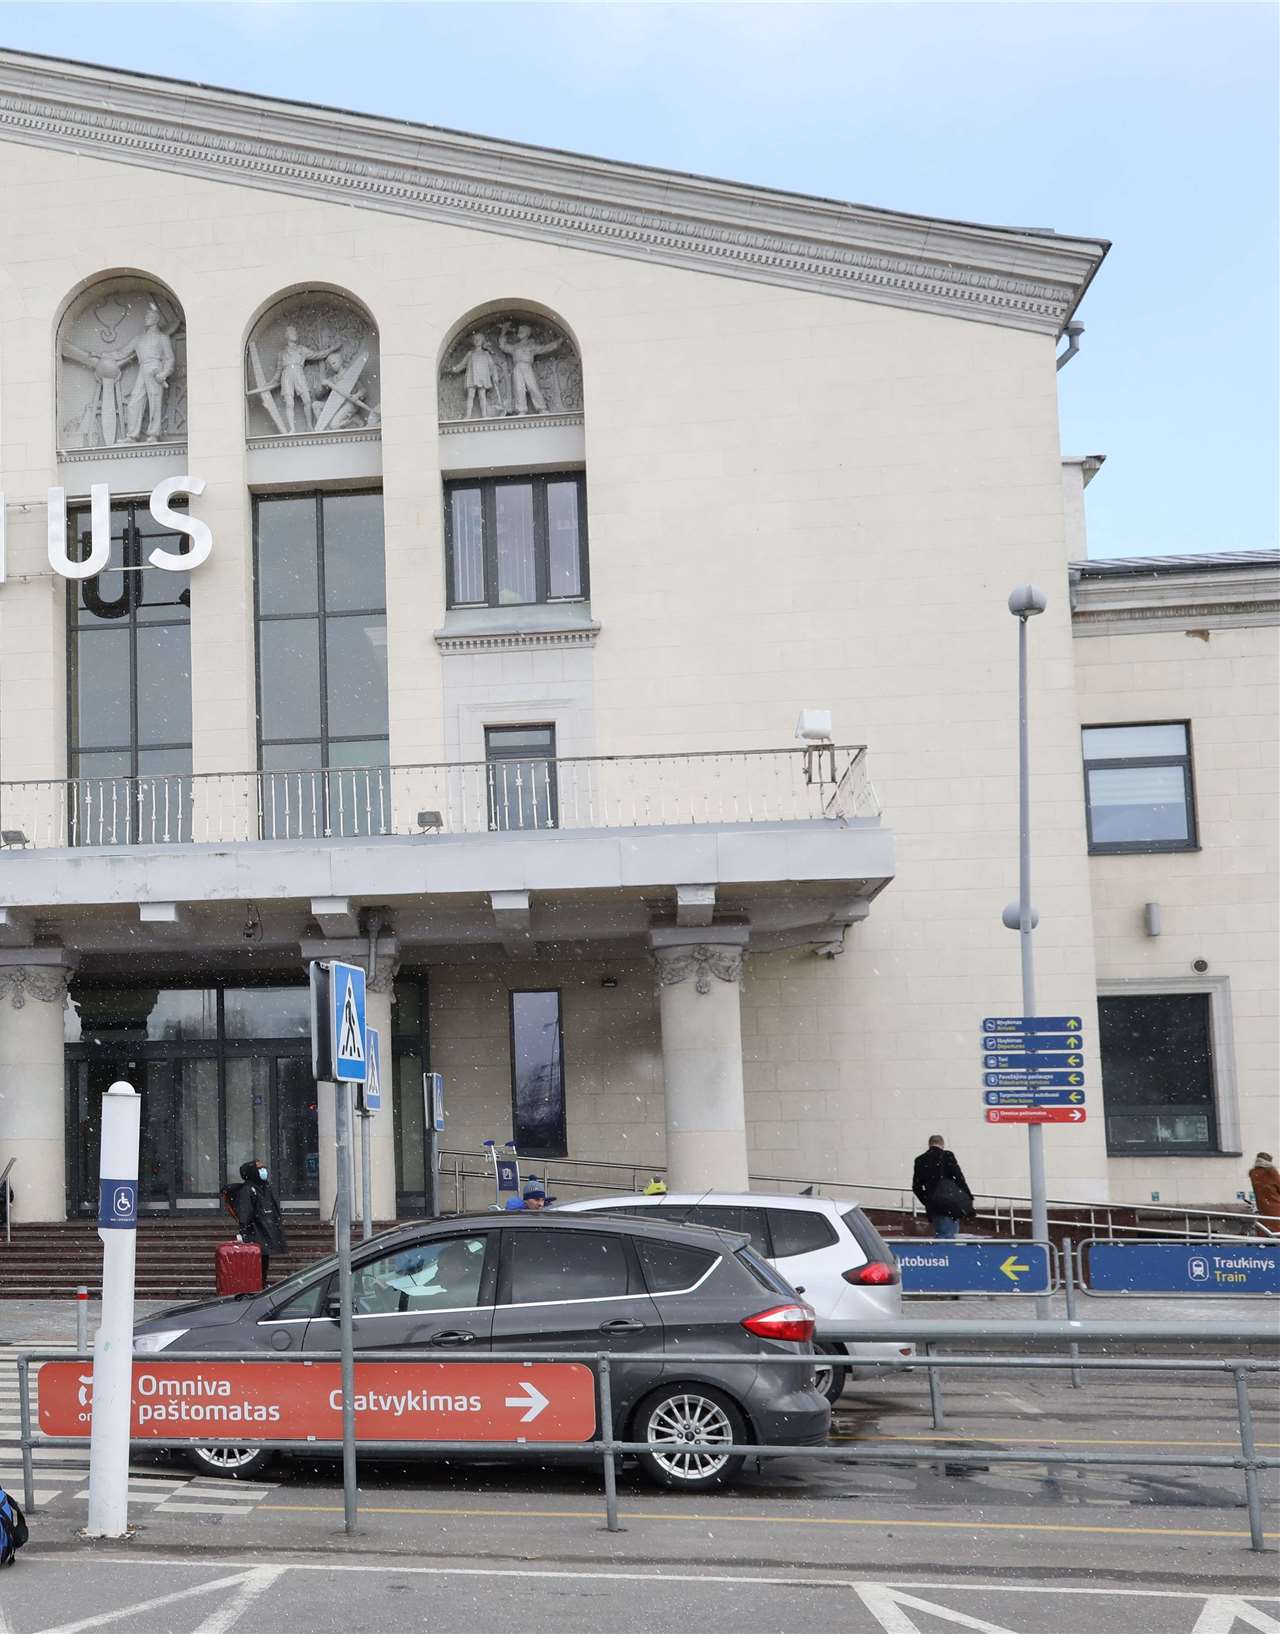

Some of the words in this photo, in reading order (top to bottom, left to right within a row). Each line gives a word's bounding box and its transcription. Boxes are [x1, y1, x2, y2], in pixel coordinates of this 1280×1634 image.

[897, 1255, 949, 1267] utobusai
[1213, 1256, 1276, 1272] Traukinys
[1214, 1271, 1247, 1283] Train
[137, 1375, 232, 1397] Omniva
[138, 1400, 281, 1425] paštomatas
[353, 1389, 482, 1417] atvykimas
